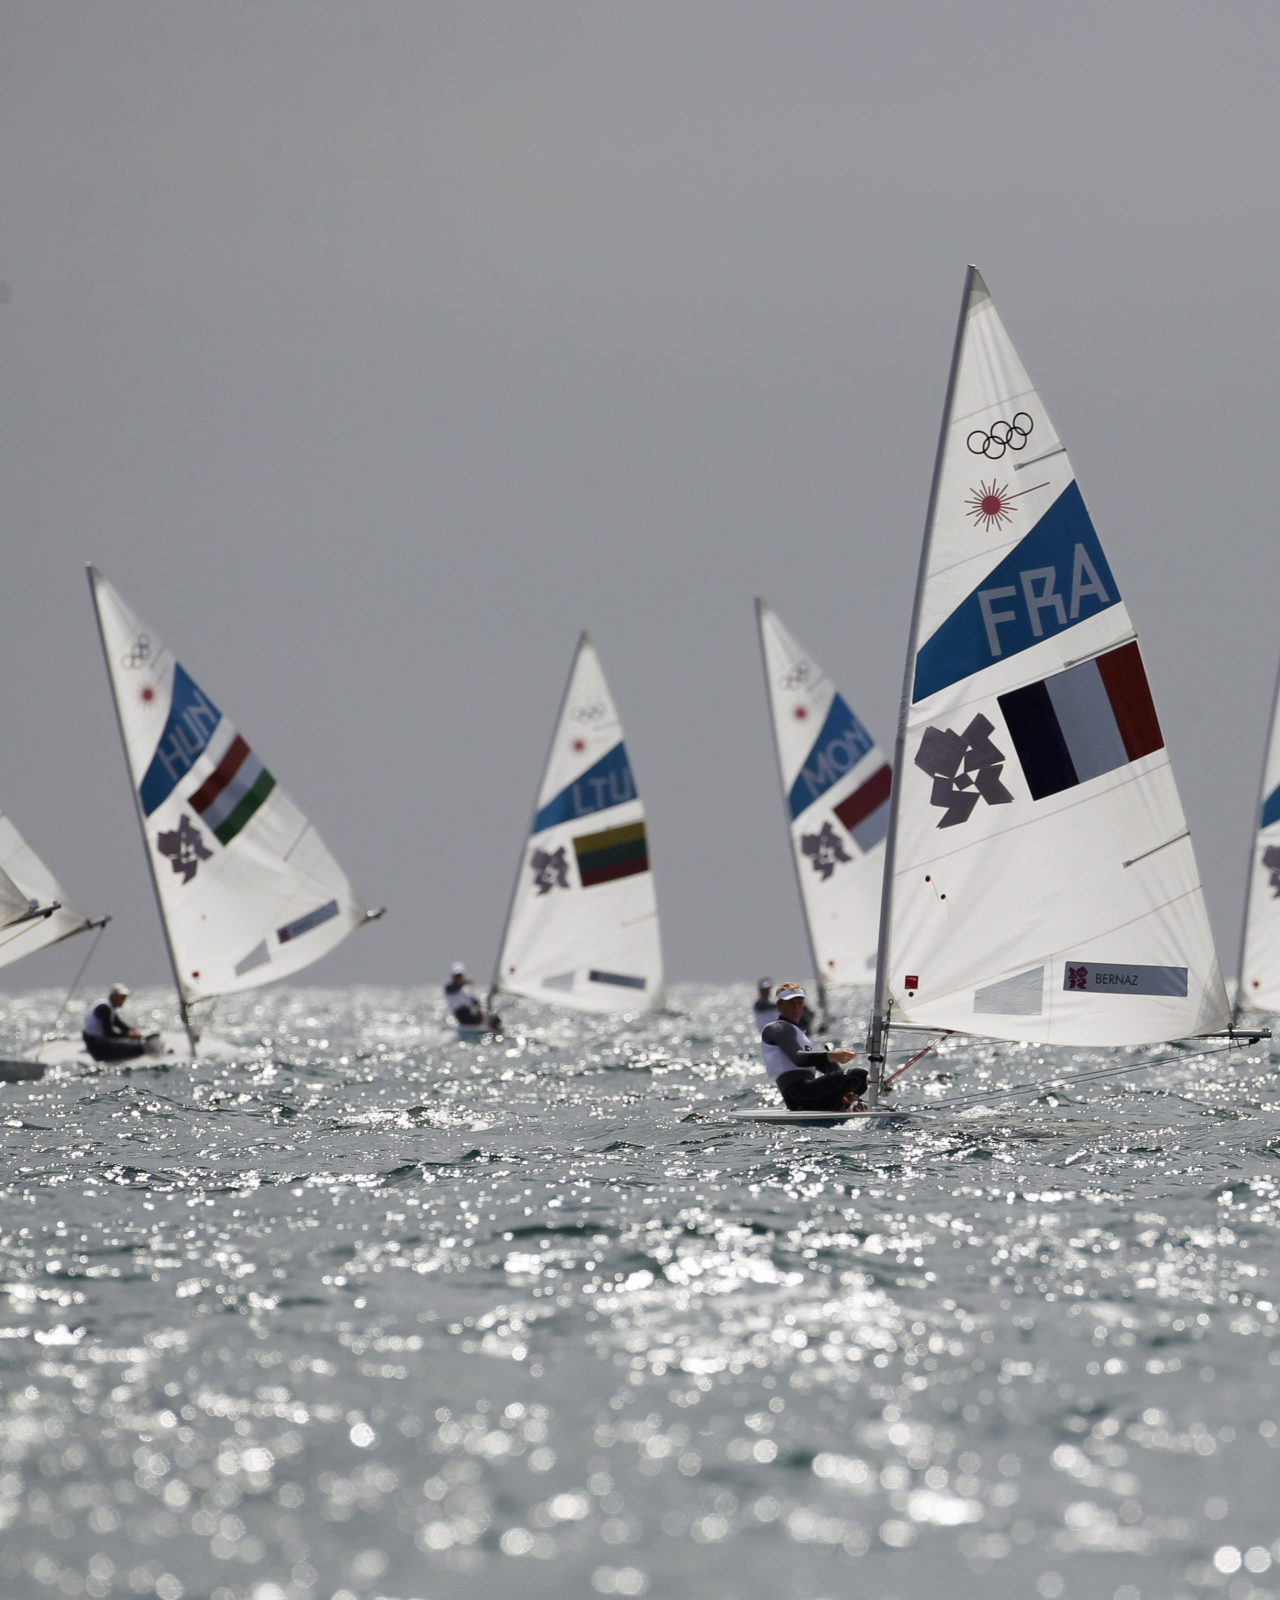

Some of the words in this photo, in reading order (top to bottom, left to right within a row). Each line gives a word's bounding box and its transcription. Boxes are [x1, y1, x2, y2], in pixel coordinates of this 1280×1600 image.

[977, 542, 1111, 657] FRA
[159, 689, 218, 781] HUN
[801, 719, 872, 799] MON
[572, 765, 634, 816] LTU
[1095, 973, 1139, 986] BERNAZ
